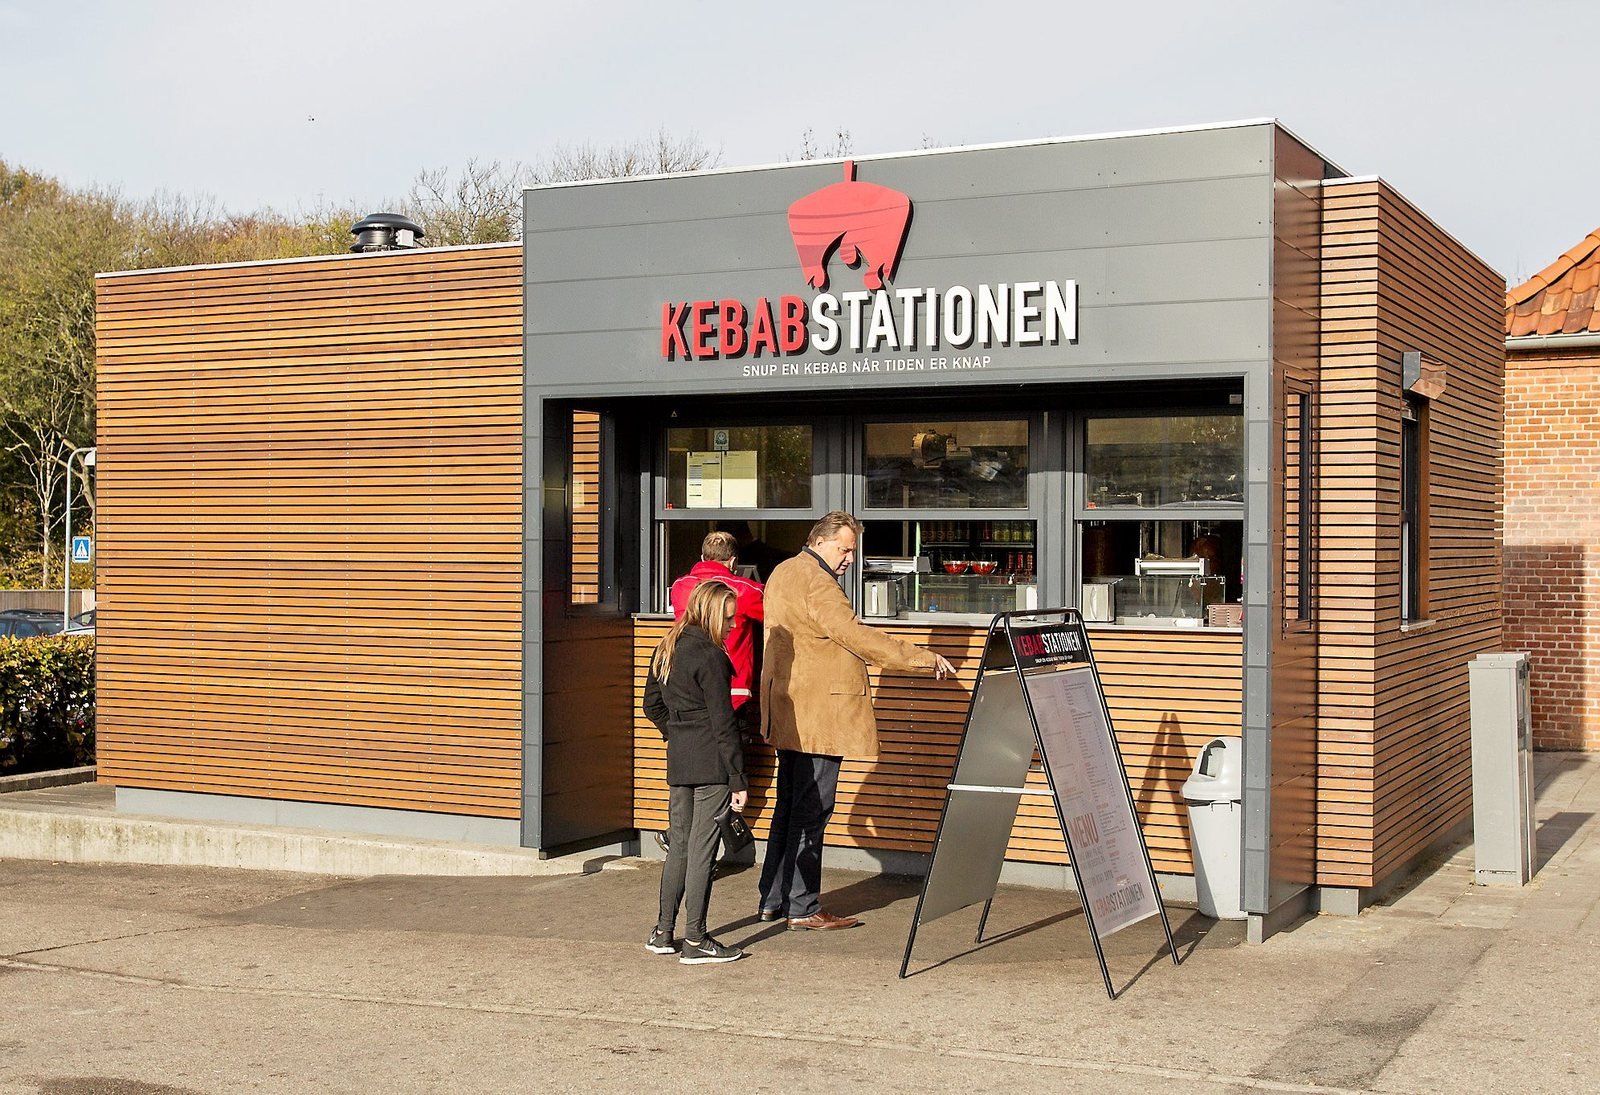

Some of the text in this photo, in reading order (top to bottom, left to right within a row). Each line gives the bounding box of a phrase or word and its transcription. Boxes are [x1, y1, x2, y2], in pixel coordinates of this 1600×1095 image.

[661, 279, 1078, 359] KEBABSTATIONEN
[743, 355, 991, 377] SNUP EN KEBAB NÅR TIDEN ER KNAP
[1014, 631, 1082, 657] KEBABSTATIONEN
[1068, 812, 1099, 849] MENU
[1093, 881, 1145, 920] EBABSTATIONEN
